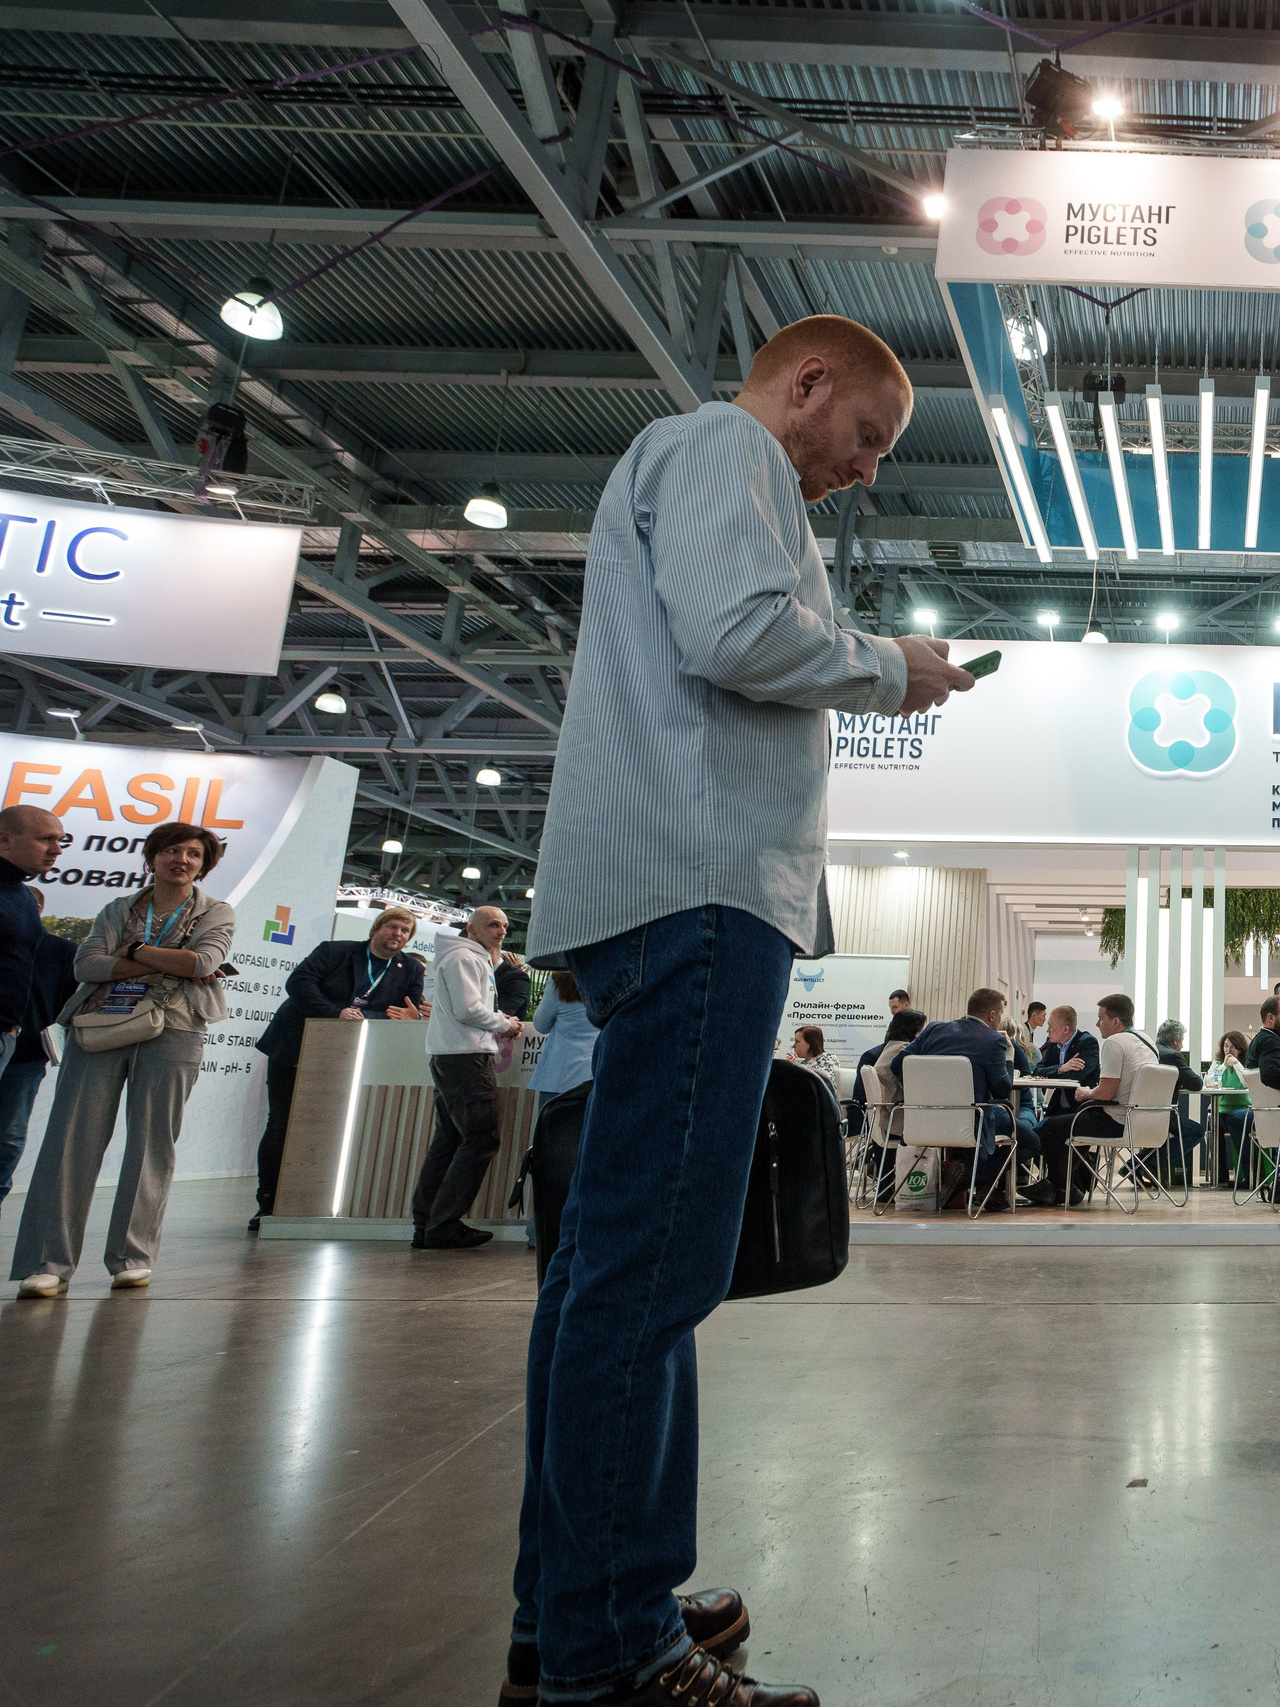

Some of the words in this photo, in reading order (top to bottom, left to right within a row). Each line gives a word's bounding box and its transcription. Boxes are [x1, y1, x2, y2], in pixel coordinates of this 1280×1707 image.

[1066, 202, 1176, 224] МУСТАНГ
[1065, 224, 1157, 247] PIGLETS
[837, 711, 942, 735] МУСТАНГ
[835, 736, 923, 759] PIGLETS
[834, 762, 875, 770] EFFECTIVE
[262, 984, 269, 995] S
[271, 985, 282, 997] 1.2
[793, 1001, 865, 1011] Онлайн-ферма
[787, 1011, 833, 1020] «Простое
[834, 1013, 884, 1021] решение»
[245, 1063, 252, 1074] 5
